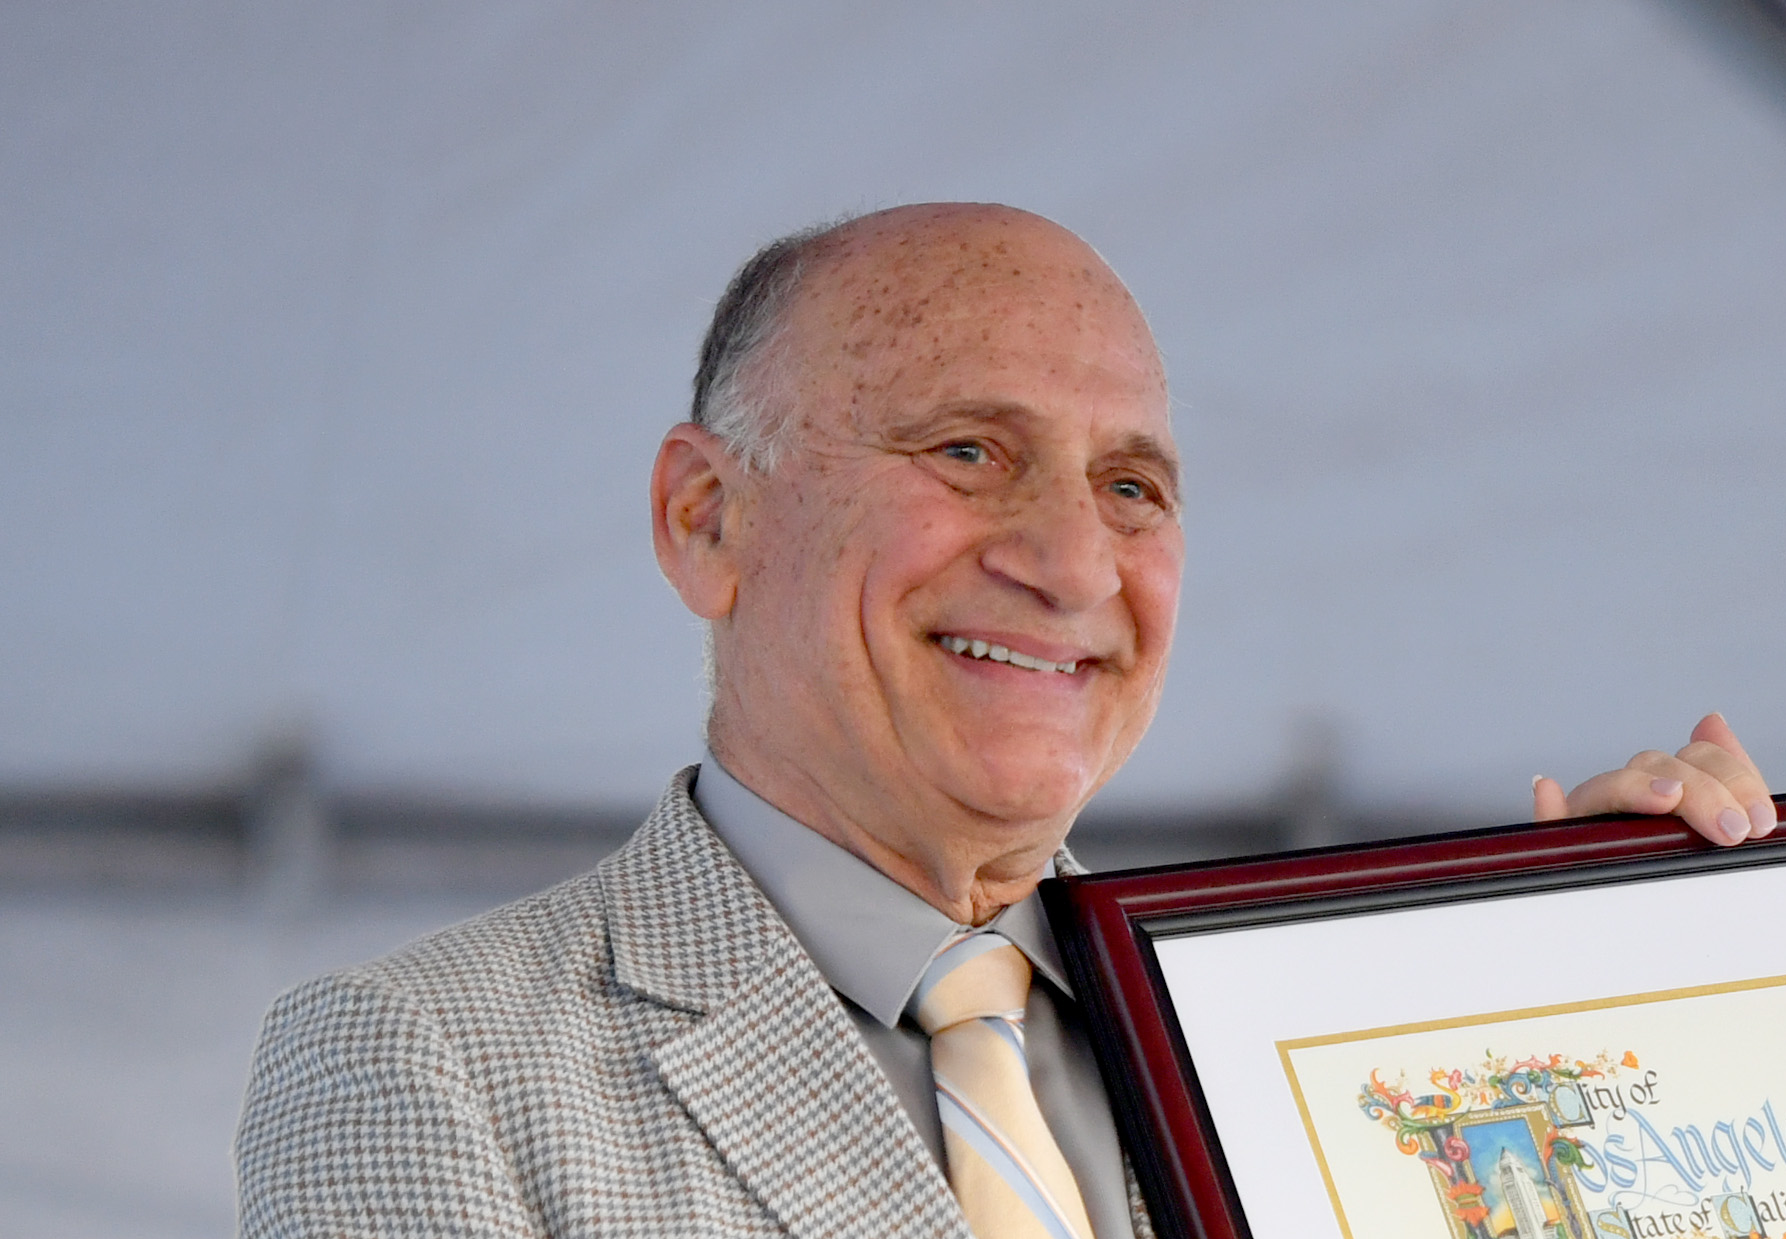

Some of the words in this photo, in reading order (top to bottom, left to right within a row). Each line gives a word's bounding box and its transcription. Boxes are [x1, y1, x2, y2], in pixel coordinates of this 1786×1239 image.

[1549, 1081, 1627, 1125] City
[1630, 1069, 1660, 1104] of
[1688, 1197, 1713, 1231] of
